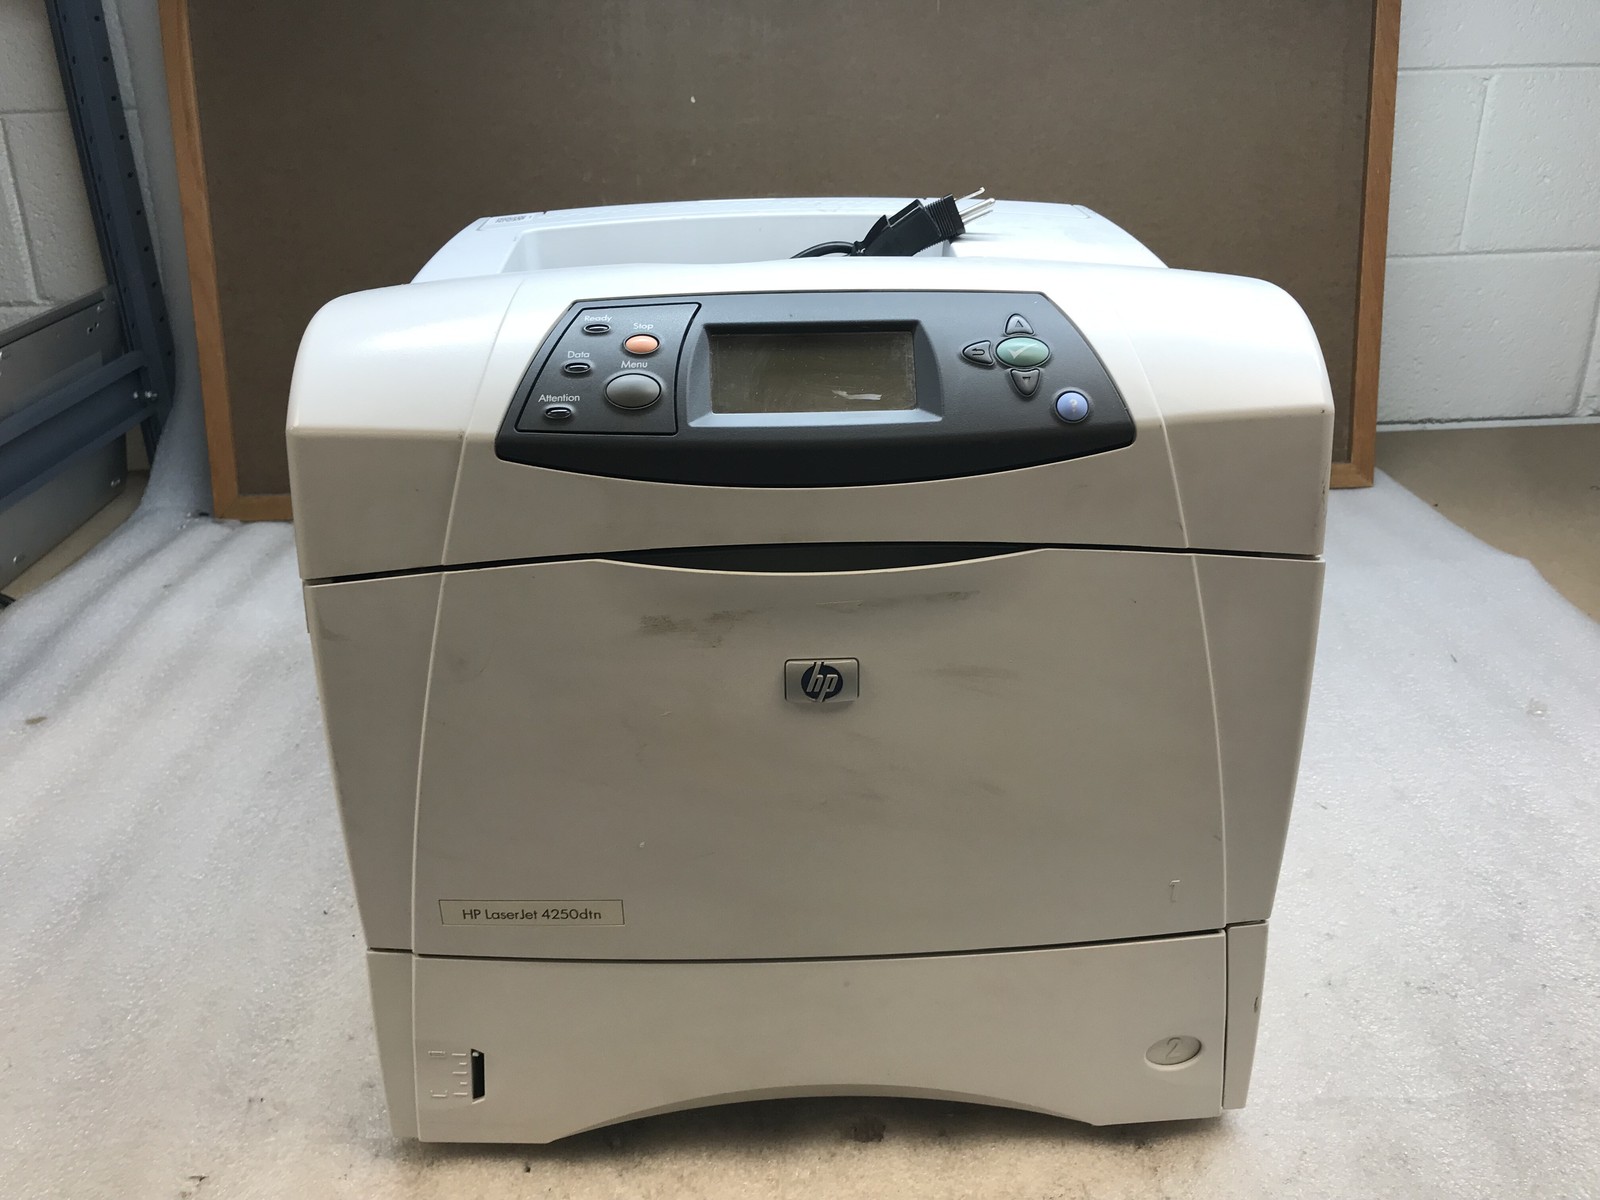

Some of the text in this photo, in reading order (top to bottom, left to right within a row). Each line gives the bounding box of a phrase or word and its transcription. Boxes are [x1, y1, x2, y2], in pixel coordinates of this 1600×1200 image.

[584, 314, 612, 323] Ready
[633, 322, 654, 331] Stop
[567, 350, 590, 359] Data
[621, 360, 648, 369] Menu
[538, 393, 580, 403] Attention
[804, 661, 840, 702] hp
[462, 908, 602, 920] HP LaserJet 4250dtn
